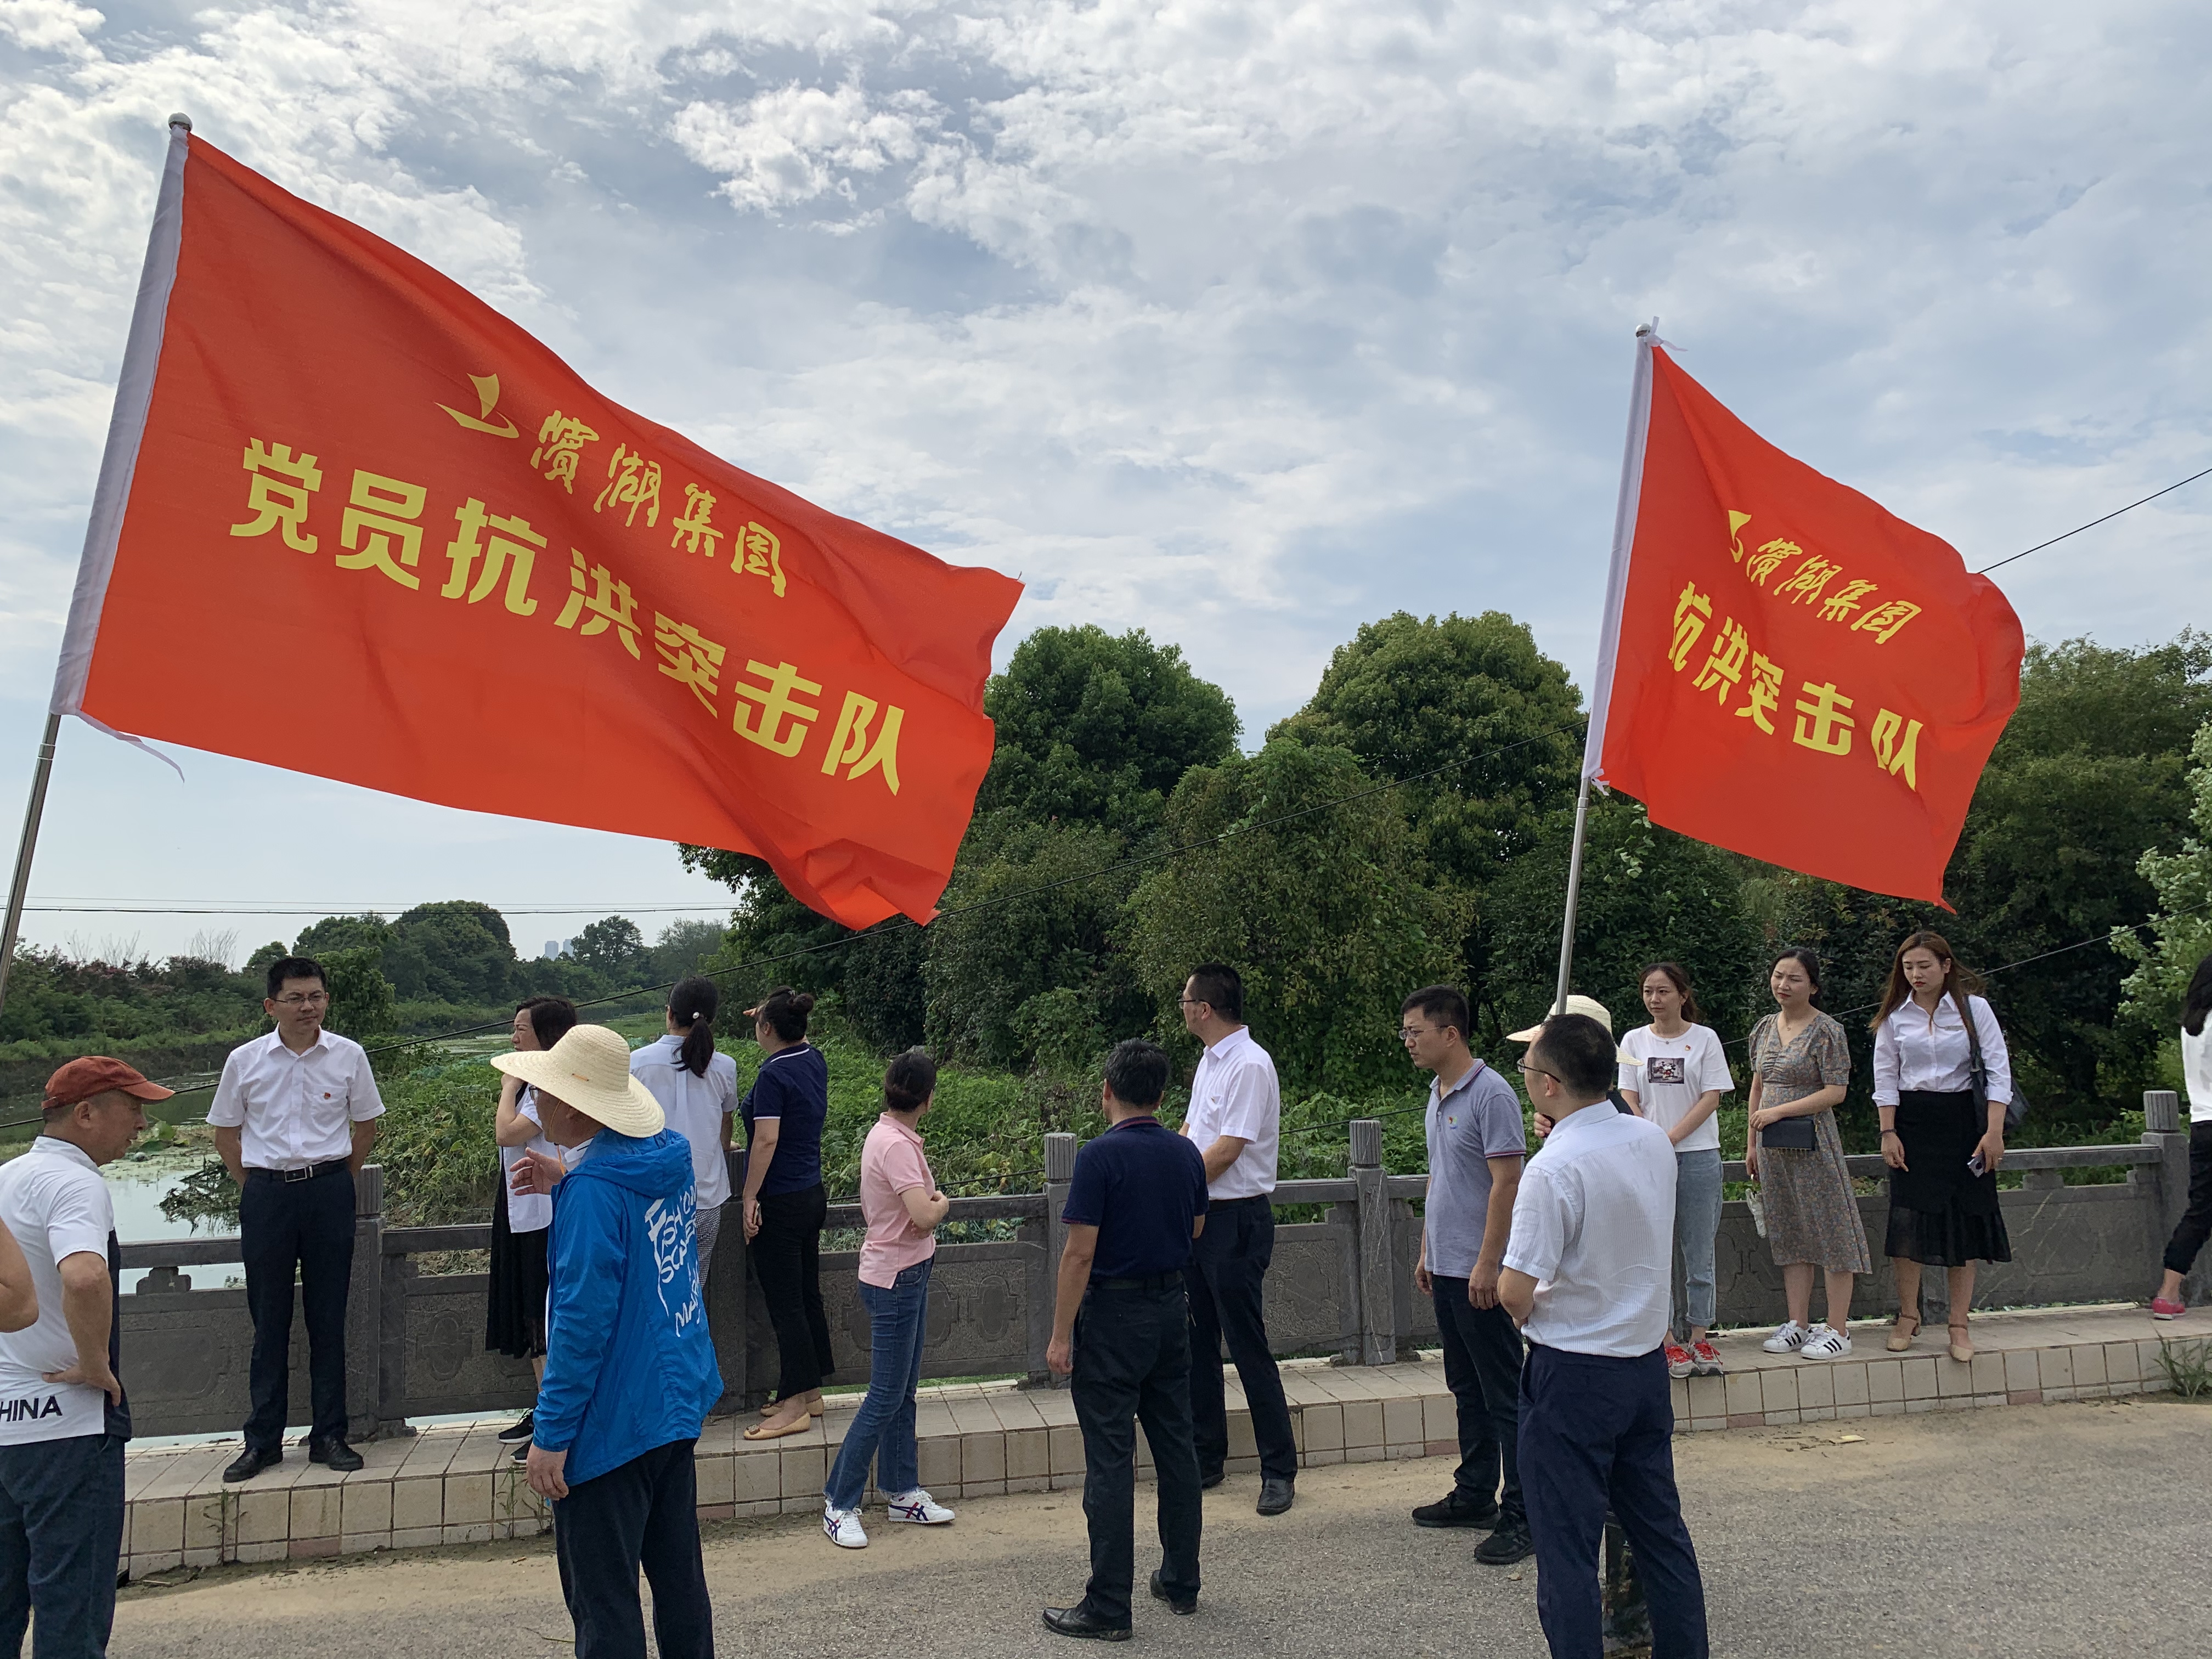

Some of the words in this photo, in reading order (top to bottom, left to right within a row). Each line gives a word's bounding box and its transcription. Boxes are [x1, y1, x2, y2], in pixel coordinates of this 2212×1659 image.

[230, 437, 905, 796] 党员抗洪突击队
[1668, 580, 1924, 792] 抗洪突击队
